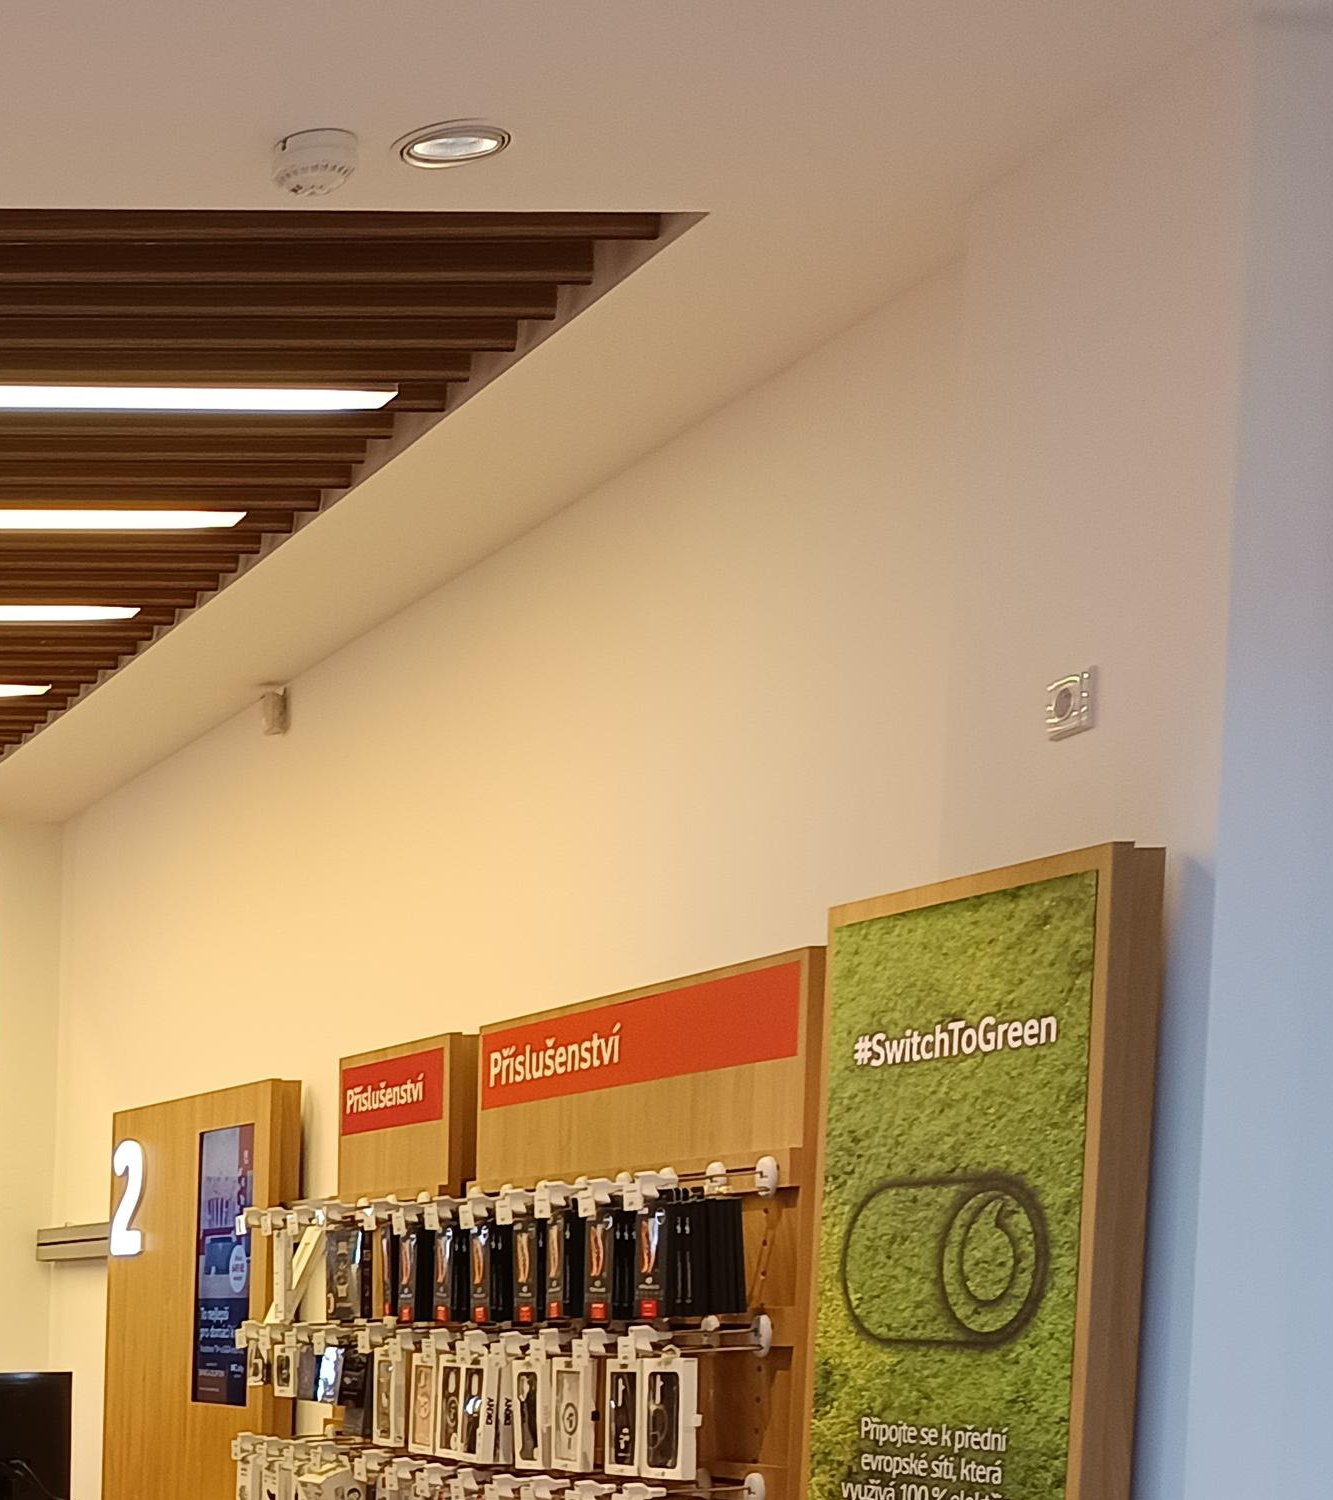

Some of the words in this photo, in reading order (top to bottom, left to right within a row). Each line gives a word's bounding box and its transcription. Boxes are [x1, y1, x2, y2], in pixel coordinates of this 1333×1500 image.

[489, 1022, 623, 1089] Příslušenství
[853, 1015, 1057, 1067] #SwitchToGreen
[345, 1072, 424, 1115] Příslušenství
[110, 1139, 144, 1256] 2
[861, 1416, 918, 1447] Připojte
[920, 1426, 938, 1446] se
[941, 1424, 951, 1447] k
[954, 1424, 1009, 1453] přední
[861, 1452, 929, 1479] evropské
[931, 1454, 957, 1482] síti,
[960, 1457, 1003, 1485] která
